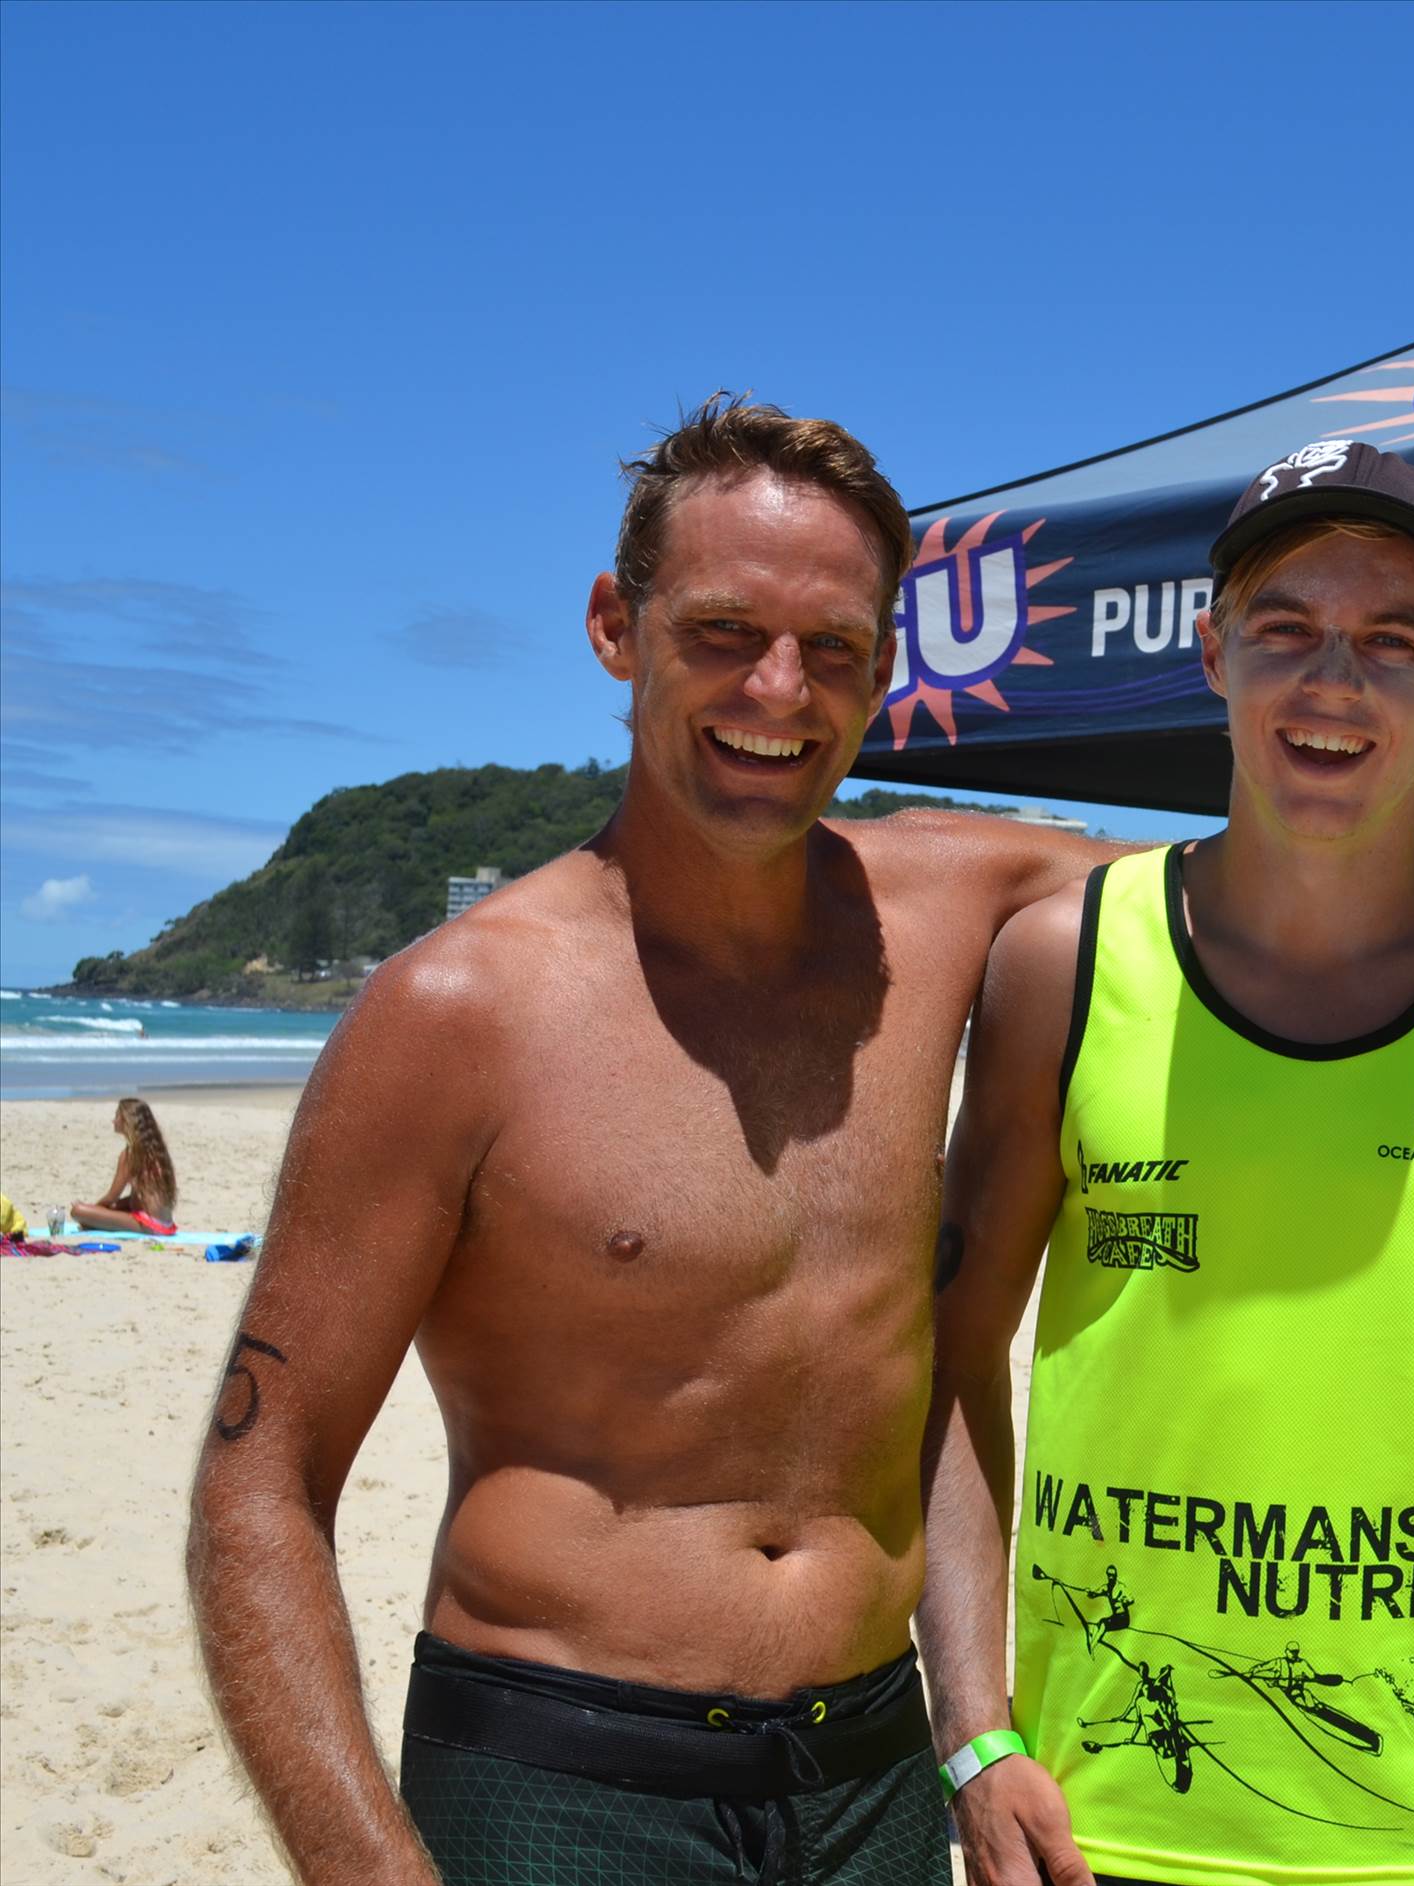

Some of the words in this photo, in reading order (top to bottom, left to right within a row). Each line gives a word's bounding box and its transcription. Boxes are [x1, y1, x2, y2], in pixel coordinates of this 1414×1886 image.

[888, 547, 1018, 694] U
[1091, 578, 1213, 657] PUR
[1087, 1159, 1189, 1184] FANATIC
